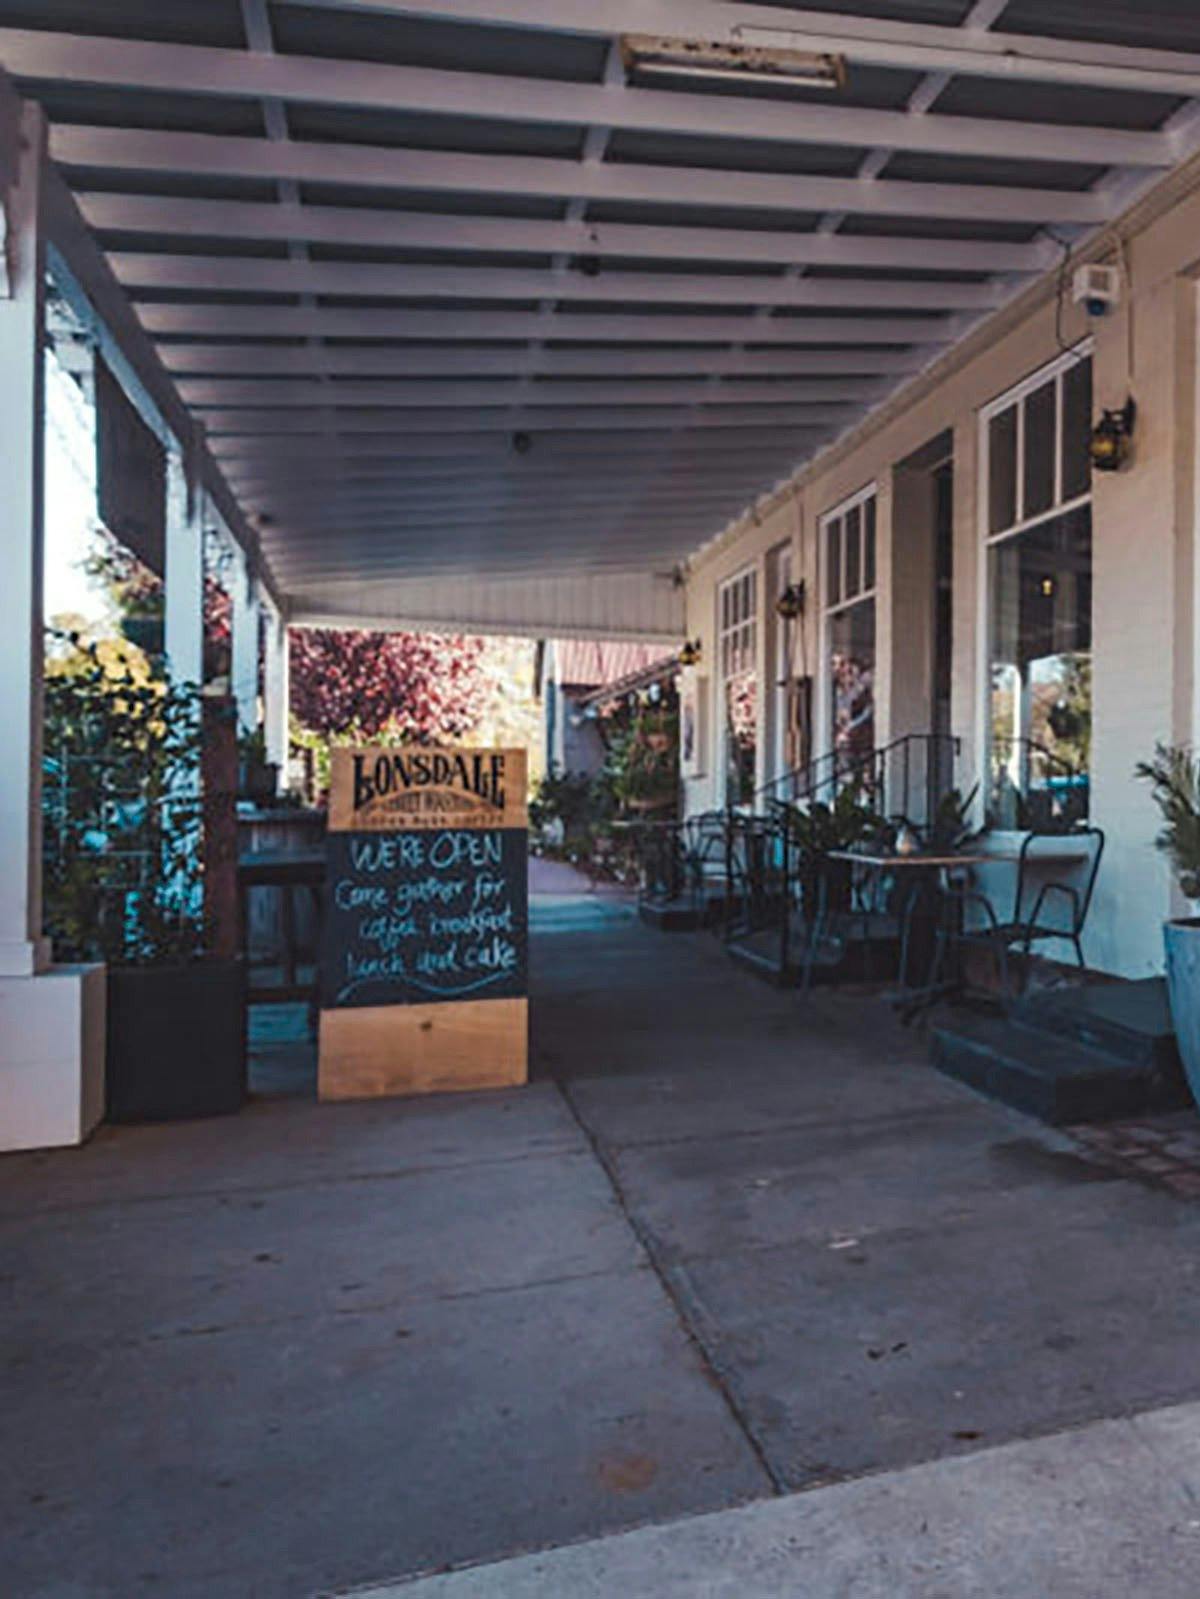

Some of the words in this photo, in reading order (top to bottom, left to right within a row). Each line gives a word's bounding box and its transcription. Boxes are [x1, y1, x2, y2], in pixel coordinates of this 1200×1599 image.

[352, 753, 505, 810] LONSDALE
[429, 831, 502, 869] OPEN
[472, 872, 505, 911] for
